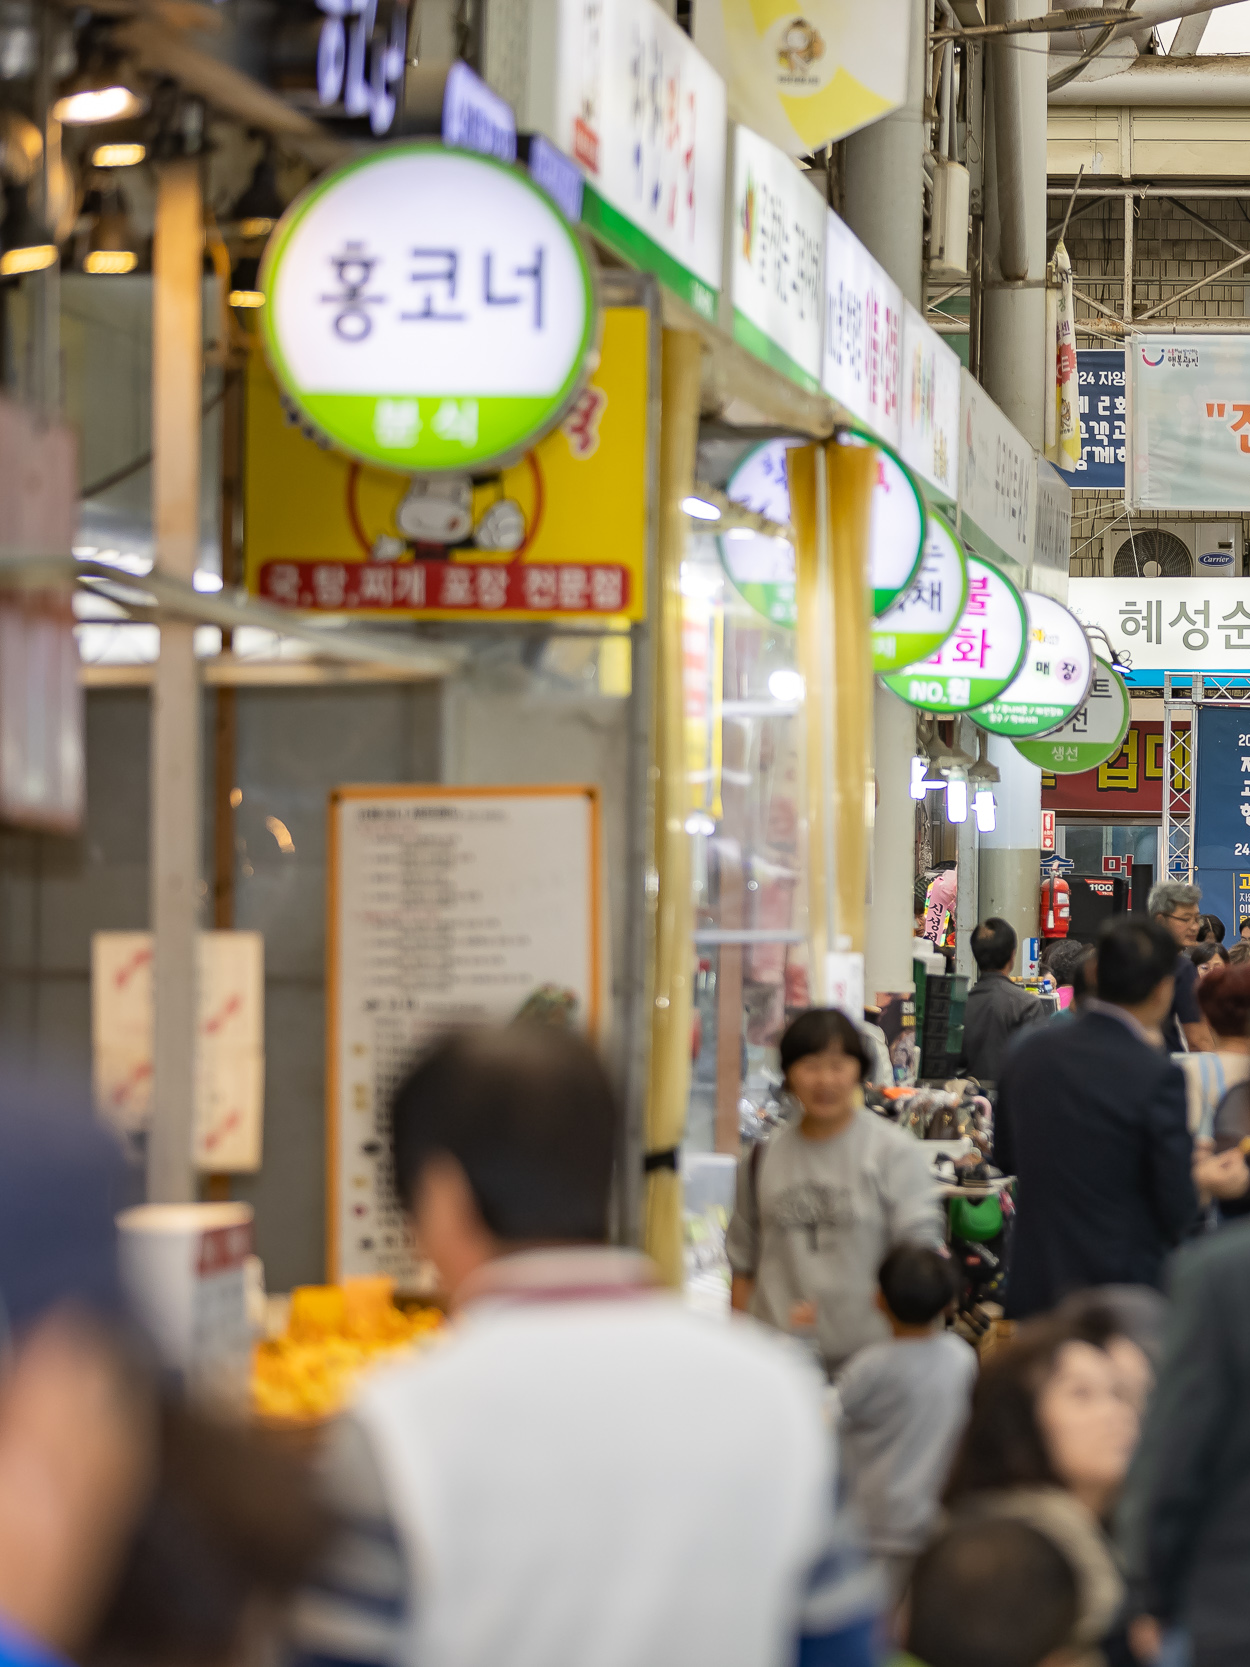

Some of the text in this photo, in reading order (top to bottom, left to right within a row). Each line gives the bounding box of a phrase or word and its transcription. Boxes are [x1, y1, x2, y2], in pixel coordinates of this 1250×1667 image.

[318, 241, 547, 344] 홍코너
[1202, 555, 1230, 564] Carrier
[1051, 746, 1079, 762] 생선
